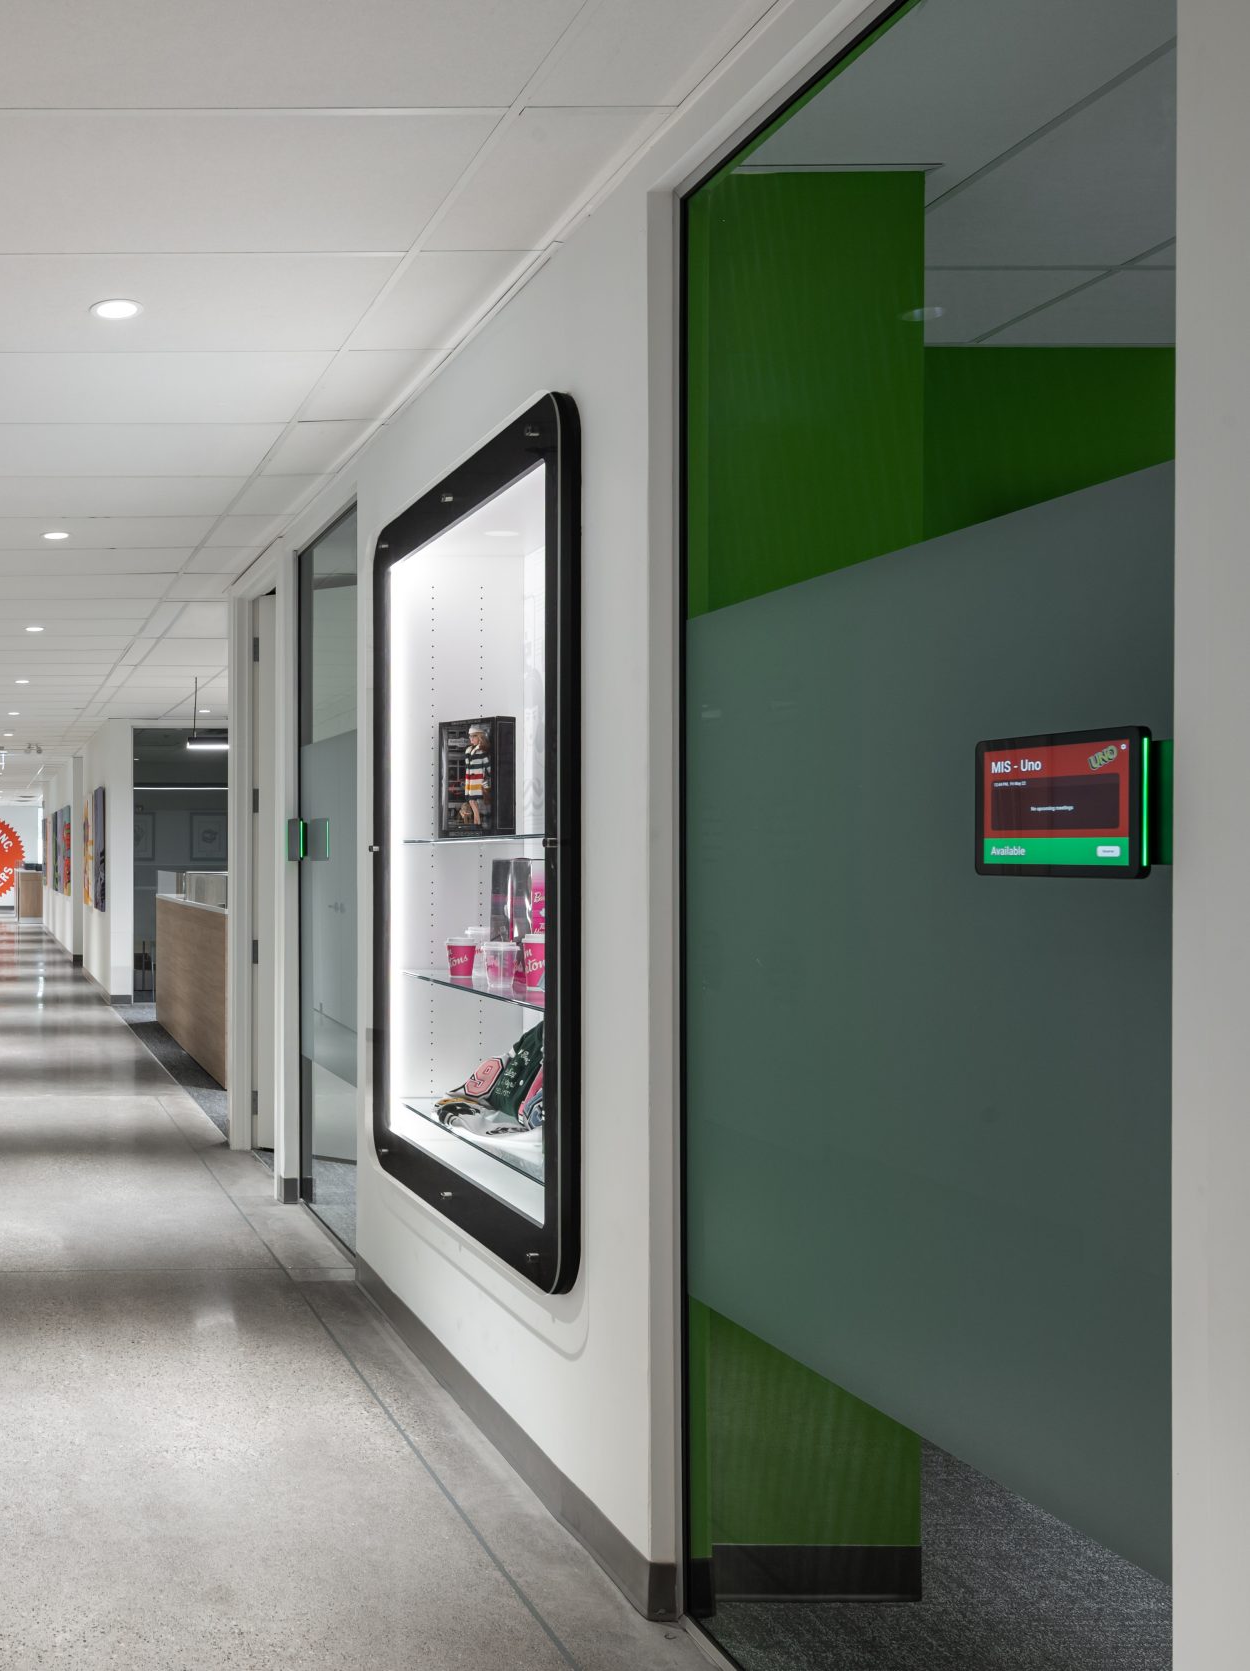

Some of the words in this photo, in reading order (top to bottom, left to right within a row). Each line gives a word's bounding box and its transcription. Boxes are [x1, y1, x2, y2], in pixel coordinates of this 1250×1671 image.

[1088, 745, 1117, 770] UNO
[991, 761, 1011, 773] MIS
[1020, 759, 1042, 772] Uno
[990, 845, 1026, 856] Available
